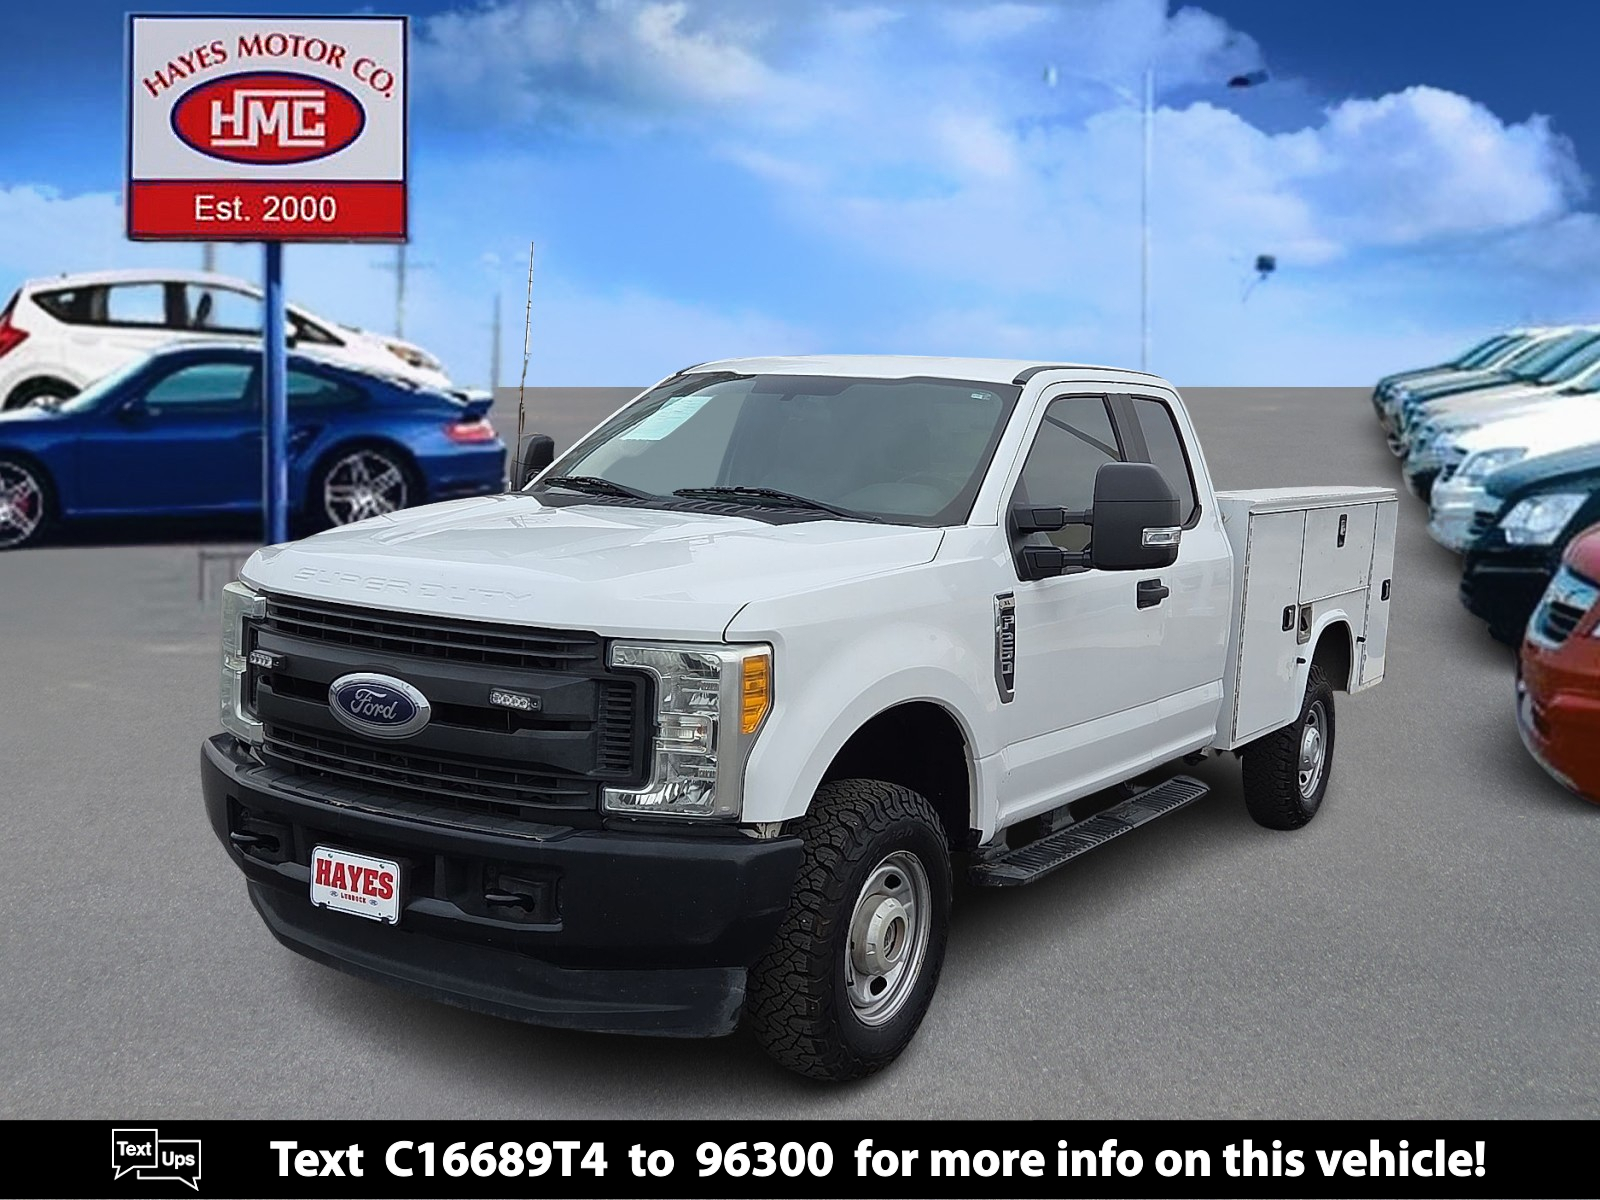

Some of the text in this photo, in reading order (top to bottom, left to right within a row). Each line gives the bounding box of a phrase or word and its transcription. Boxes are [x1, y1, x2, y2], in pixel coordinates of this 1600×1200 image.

[142, 33, 396, 99] HAYES MOTOR CO.
[210, 89, 326, 148] HMC
[194, 194, 337, 222] Est. 2000
[293, 566, 537, 607] SUPER DUTY
[350, 688, 399, 720] Ford
[315, 858, 394, 900] HAYES
